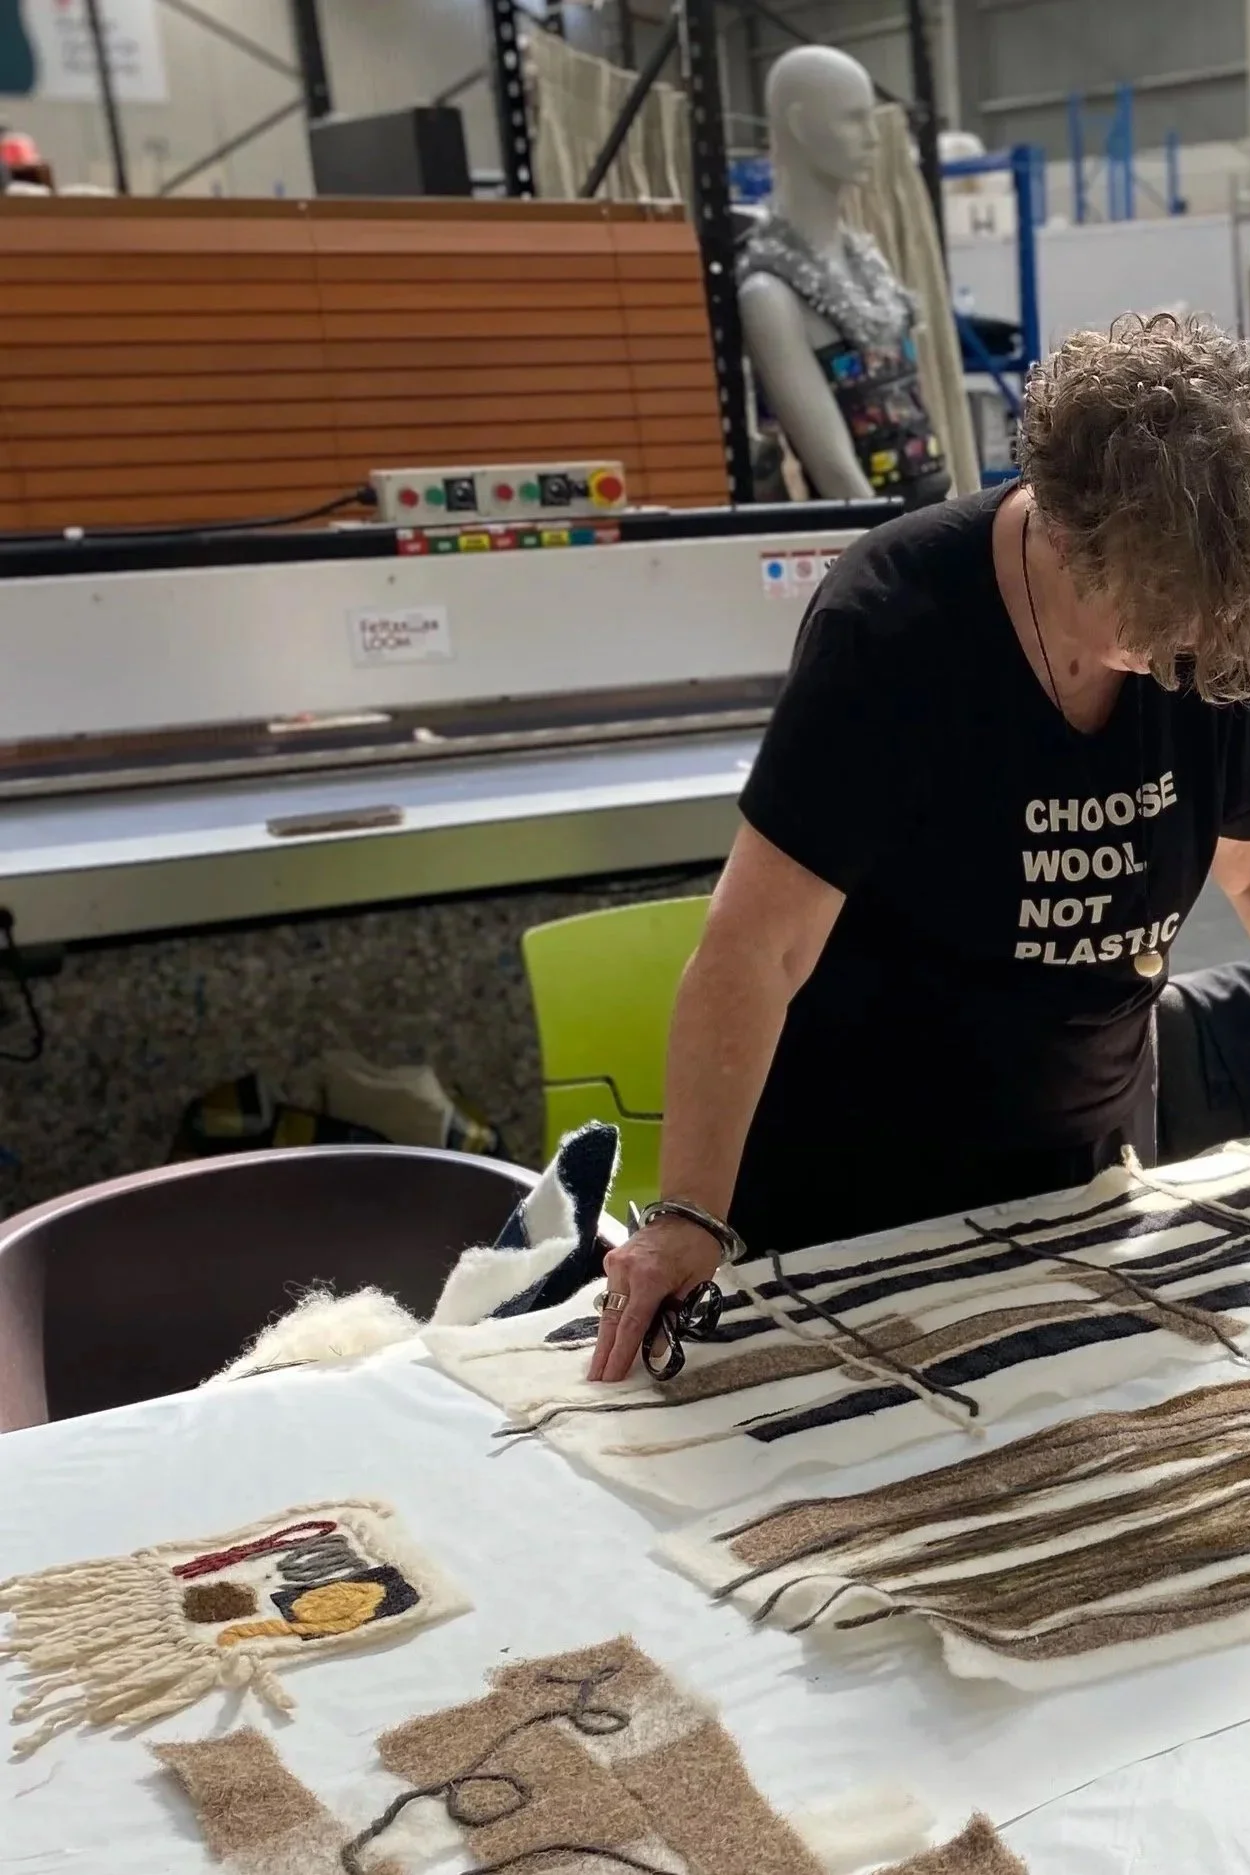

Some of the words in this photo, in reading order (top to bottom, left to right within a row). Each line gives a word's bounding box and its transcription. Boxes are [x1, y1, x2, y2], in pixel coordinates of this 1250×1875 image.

[1025, 771, 1178, 833] CHOOSE
[1018, 895, 1113, 928] NOT
[1014, 912, 1180, 965] PLASTIC
